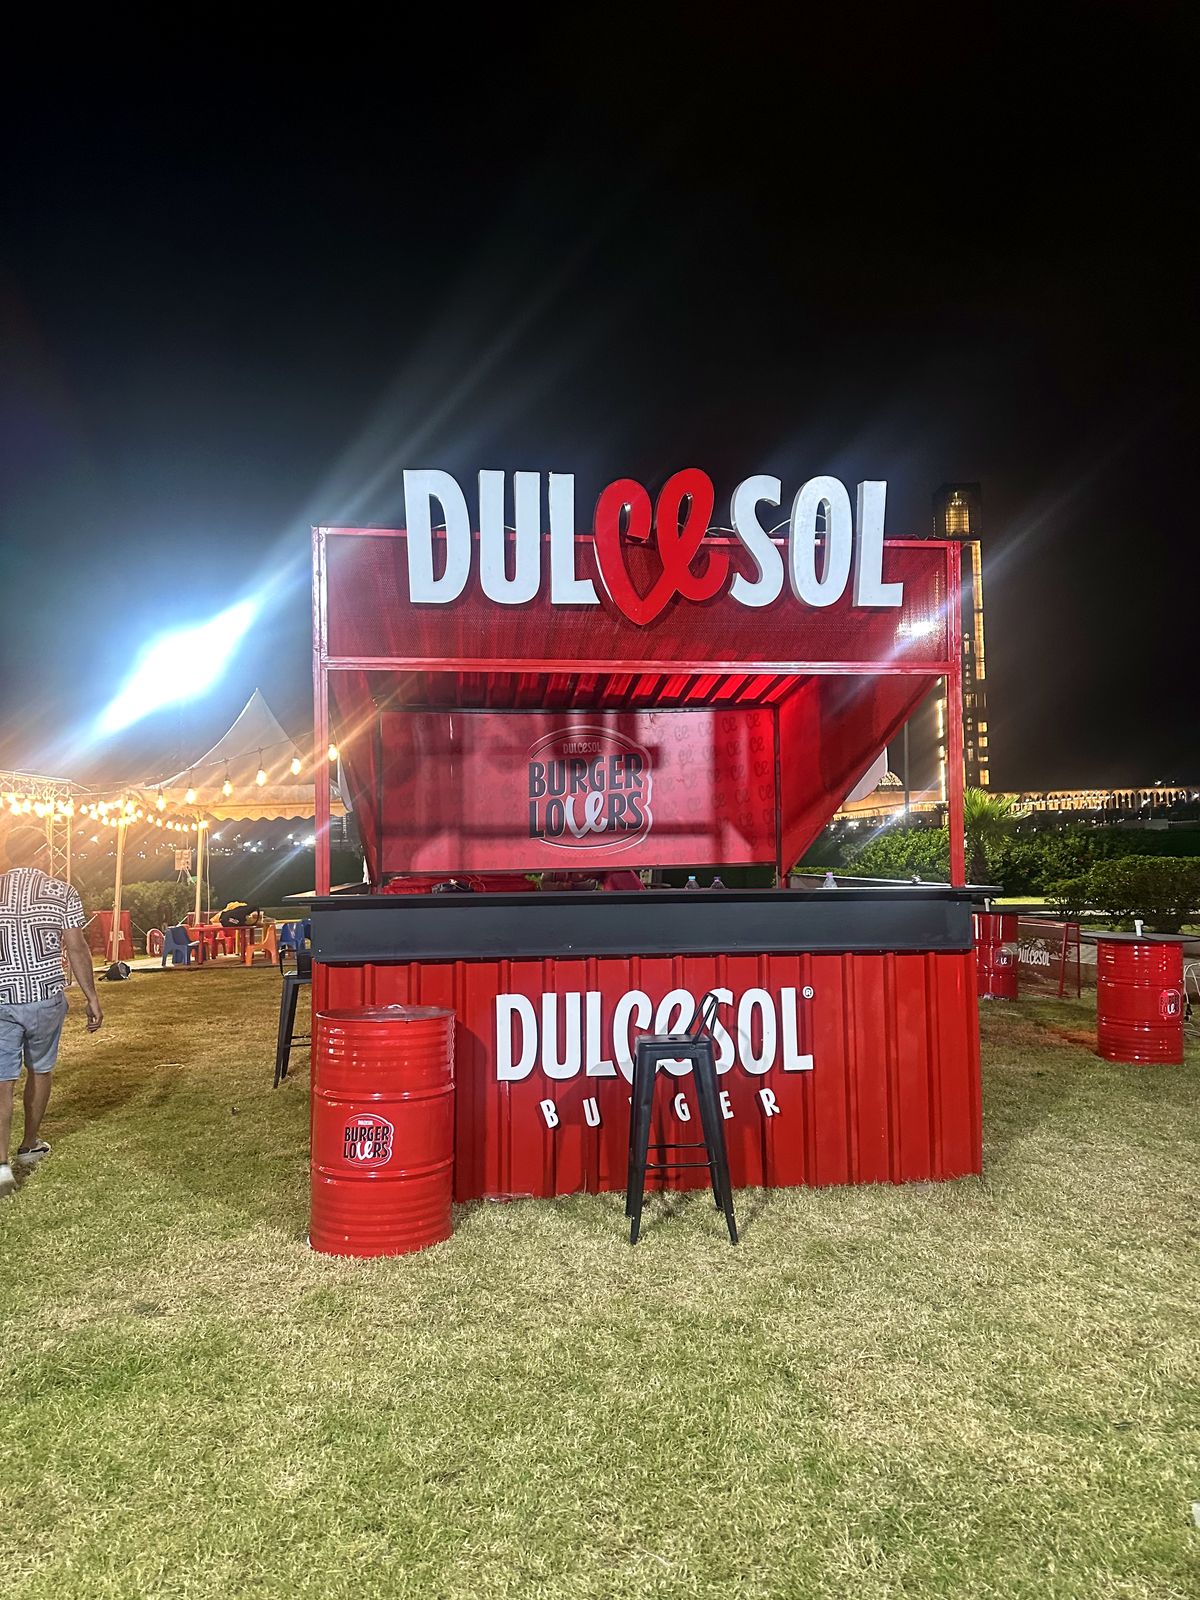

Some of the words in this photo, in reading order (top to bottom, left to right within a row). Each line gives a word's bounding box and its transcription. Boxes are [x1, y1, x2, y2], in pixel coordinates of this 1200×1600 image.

[528, 753, 643, 798] BURGER
[540, 1088, 780, 1128] BUGER
[344, 1126, 390, 1142] BURGER
